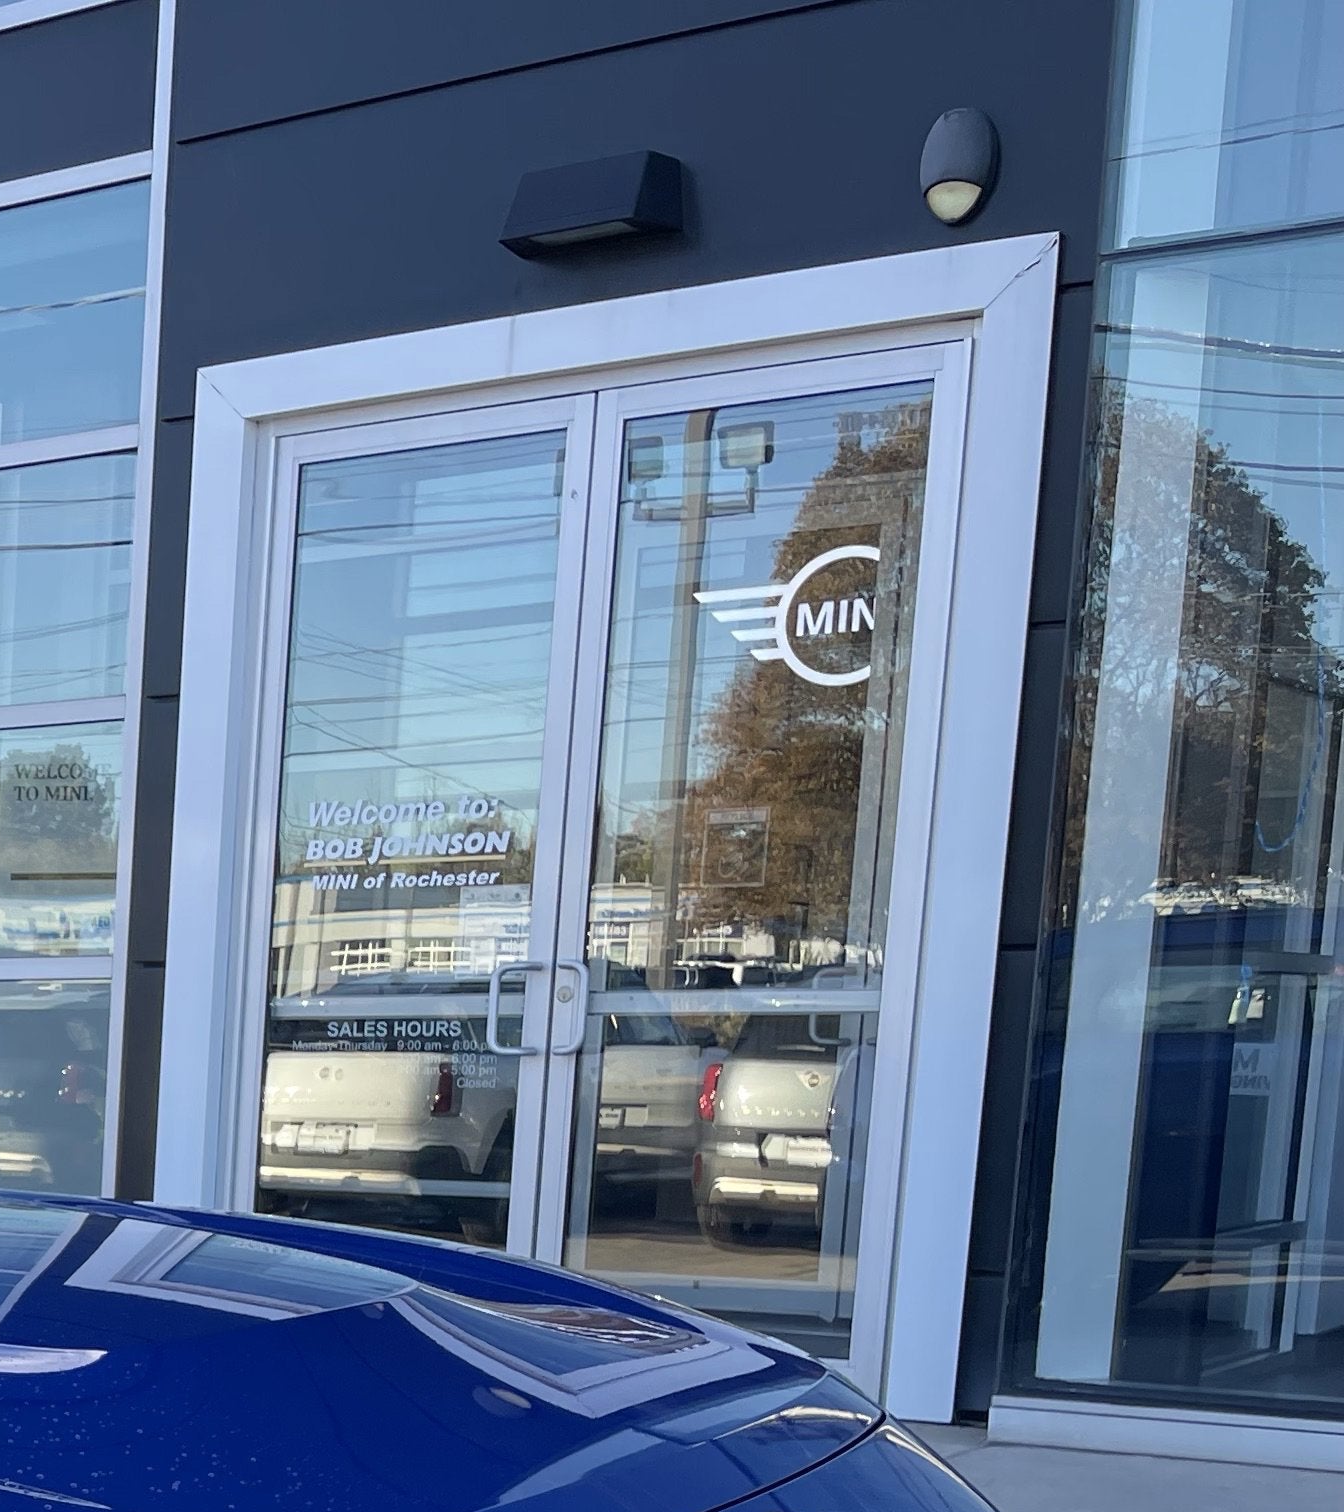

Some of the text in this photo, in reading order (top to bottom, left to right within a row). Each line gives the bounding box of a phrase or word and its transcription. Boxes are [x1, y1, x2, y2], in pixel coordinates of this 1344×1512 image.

[14, 785, 39, 802] TO
[310, 796, 499, 827] Welcome to:
[305, 831, 511, 865] BOB JOHNSON
[312, 869, 501, 890] MINI of Rochester
[327, 1020, 462, 1037] SALES HOURS
[397, 1041, 421, 1051] 9:00
[424, 1043, 442, 1051] am
[451, 1053, 477, 1064] 6:00
[479, 1055, 498, 1067] pm
[451, 1065, 477, 1076] 5:00
[478, 1067, 497, 1079] pm
[456, 1077, 497, 1089] Closed
